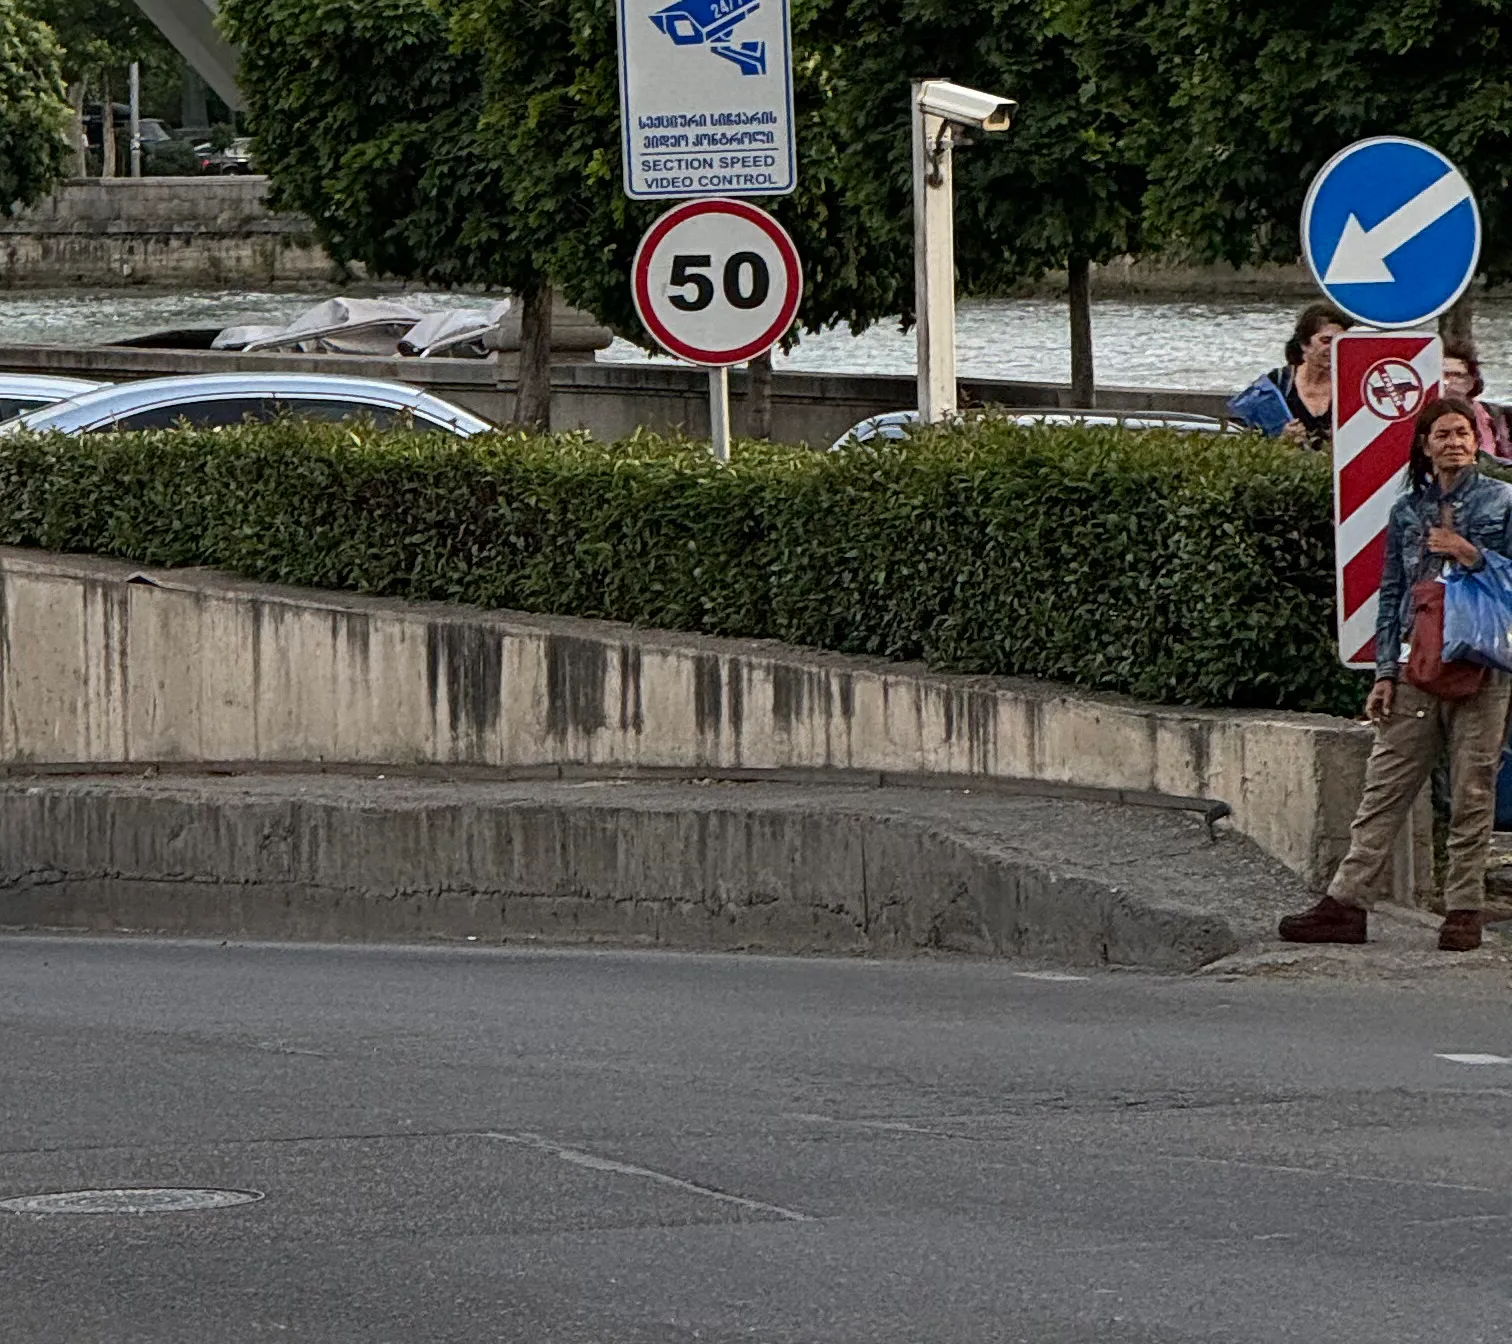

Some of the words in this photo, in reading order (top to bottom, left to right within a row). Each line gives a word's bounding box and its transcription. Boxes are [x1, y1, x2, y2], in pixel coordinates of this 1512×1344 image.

[643, 134, 689, 149] ვიდეო
[692, 130, 775, 148] კონტროლი
[641, 158, 714, 172] SECTION
[719, 155, 775, 169] SPEED
[644, 176, 693, 189] VIDEO
[698, 173, 777, 187] CONTROL
[668, 251, 770, 312] 50
